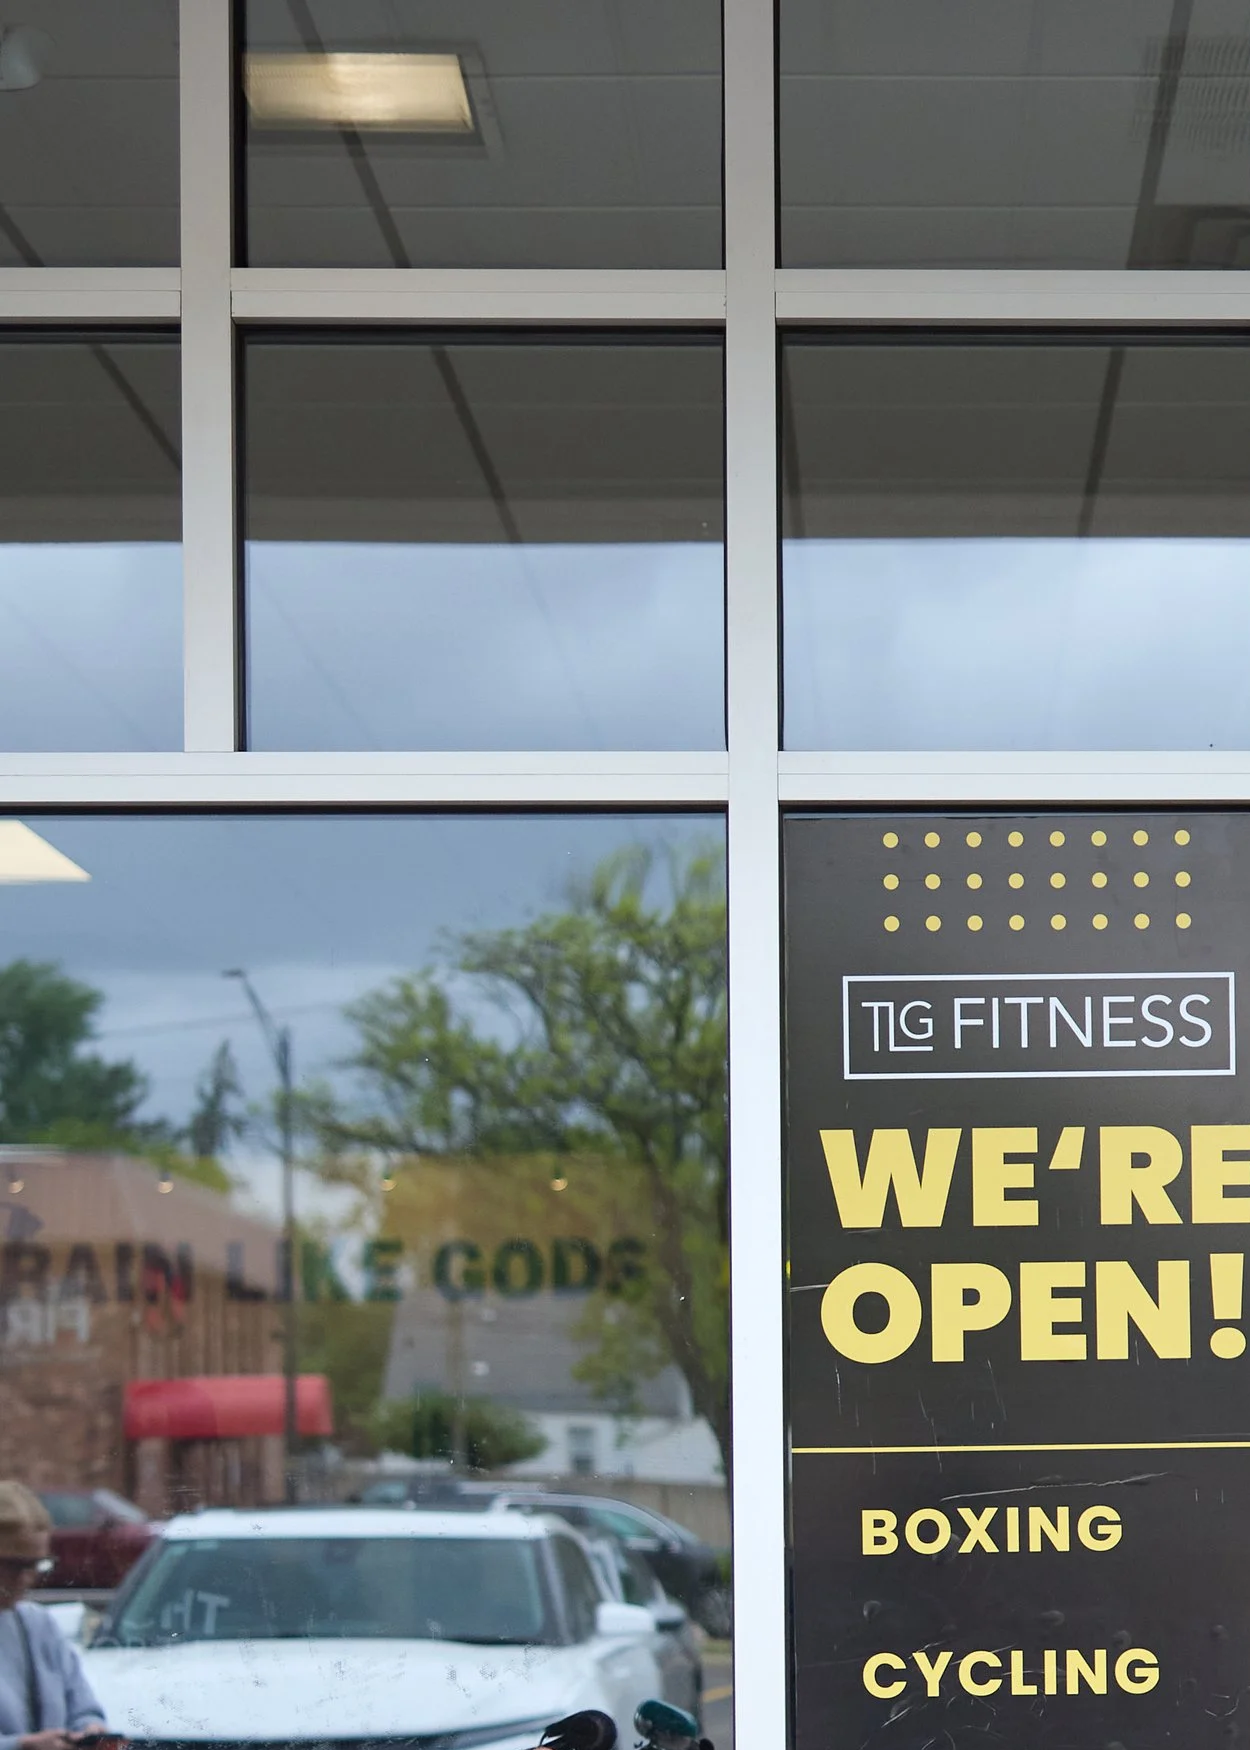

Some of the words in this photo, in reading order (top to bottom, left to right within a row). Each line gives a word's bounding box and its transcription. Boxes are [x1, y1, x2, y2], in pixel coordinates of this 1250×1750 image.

[862, 1000, 934, 1052] TLG
[954, 994, 1216, 1049] FITNESS
[820, 1253, 1246, 1364] OPEN!
[861, 1505, 1123, 1555] BOXING
[863, 1648, 1161, 1699] CYCLING
